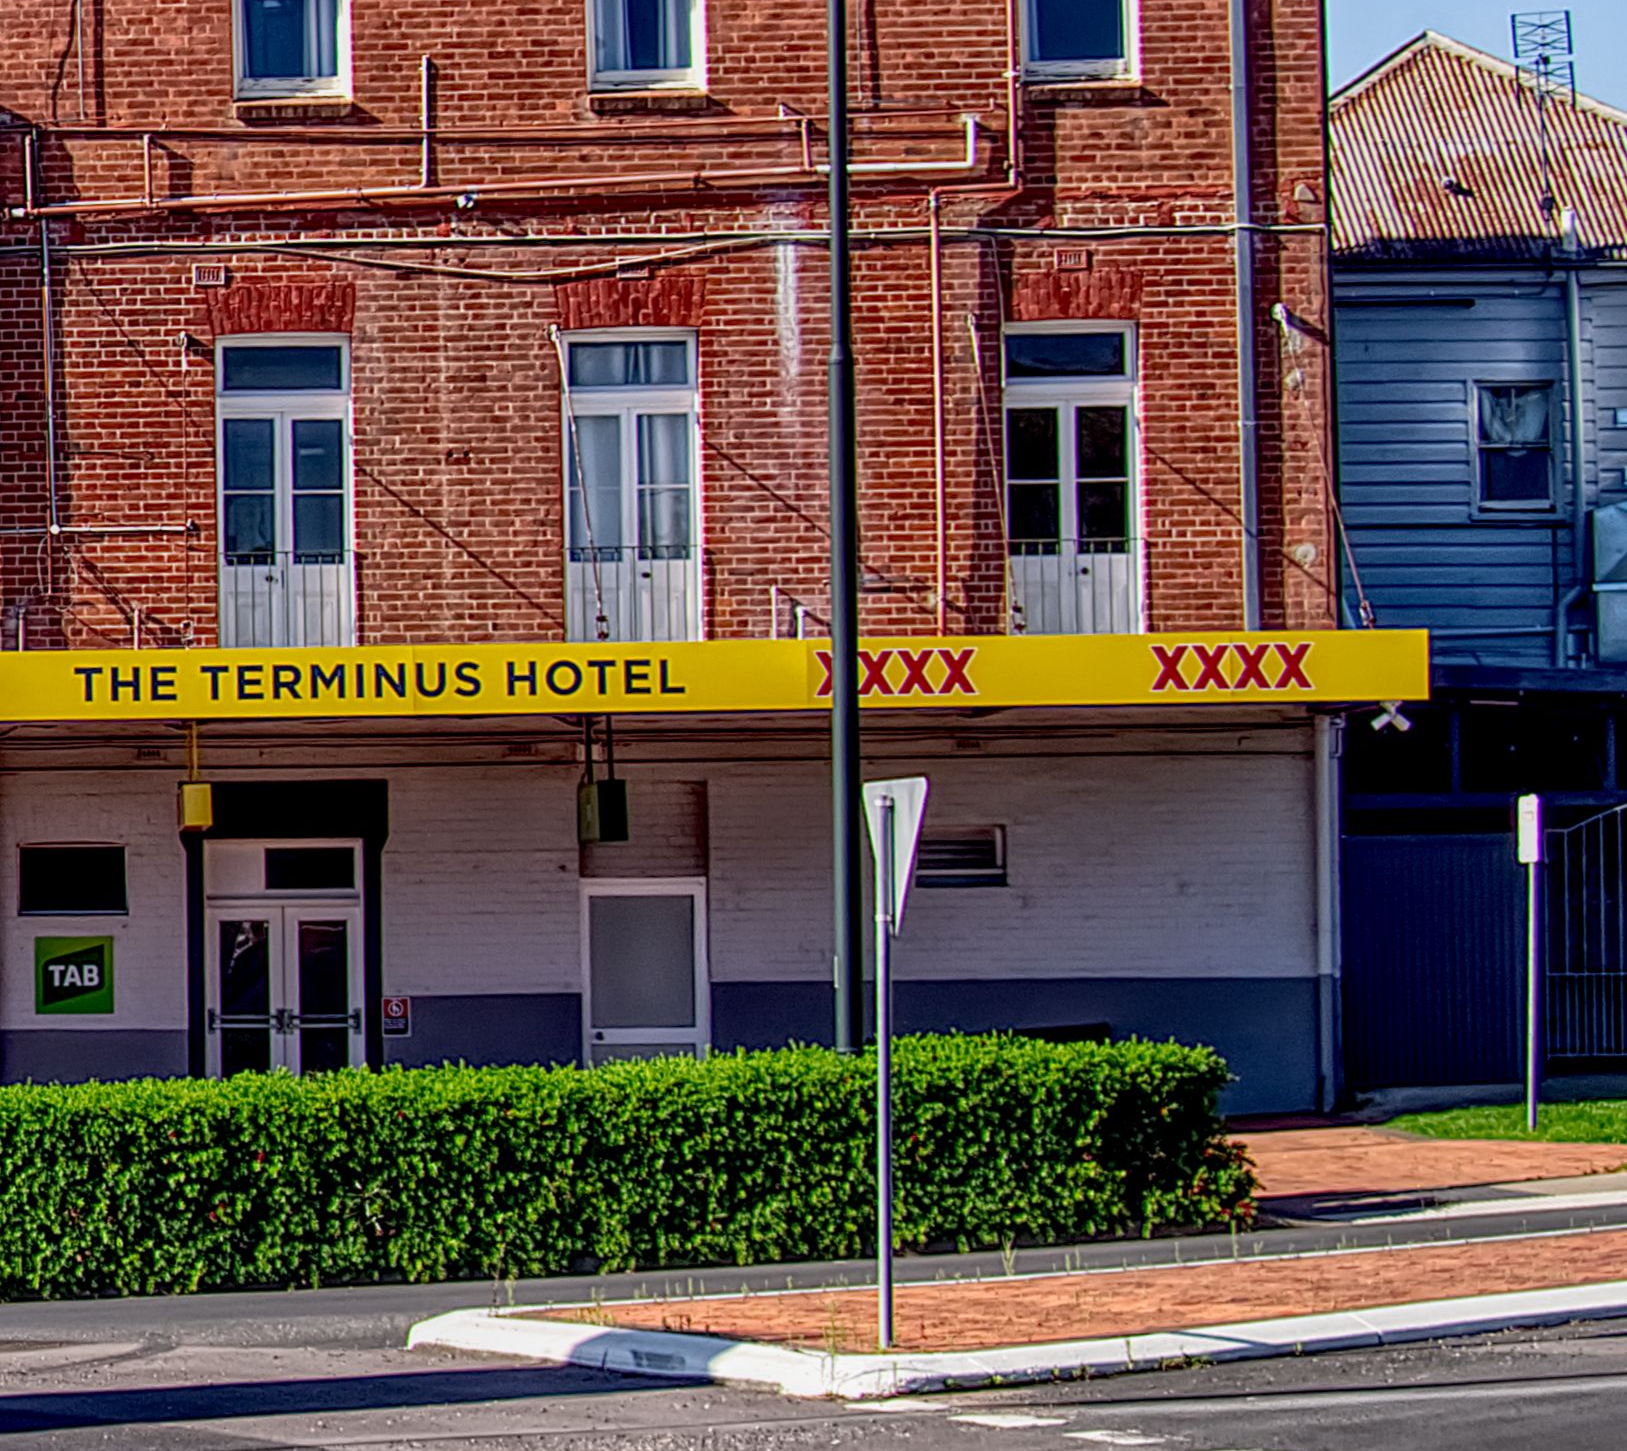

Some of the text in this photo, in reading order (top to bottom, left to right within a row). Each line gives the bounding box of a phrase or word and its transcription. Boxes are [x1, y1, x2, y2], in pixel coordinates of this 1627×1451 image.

[73, 658, 686, 703] THE TERMINUS HOTEL
[1149, 642, 1314, 692] XXXX
[48, 963, 100, 988] TAB
